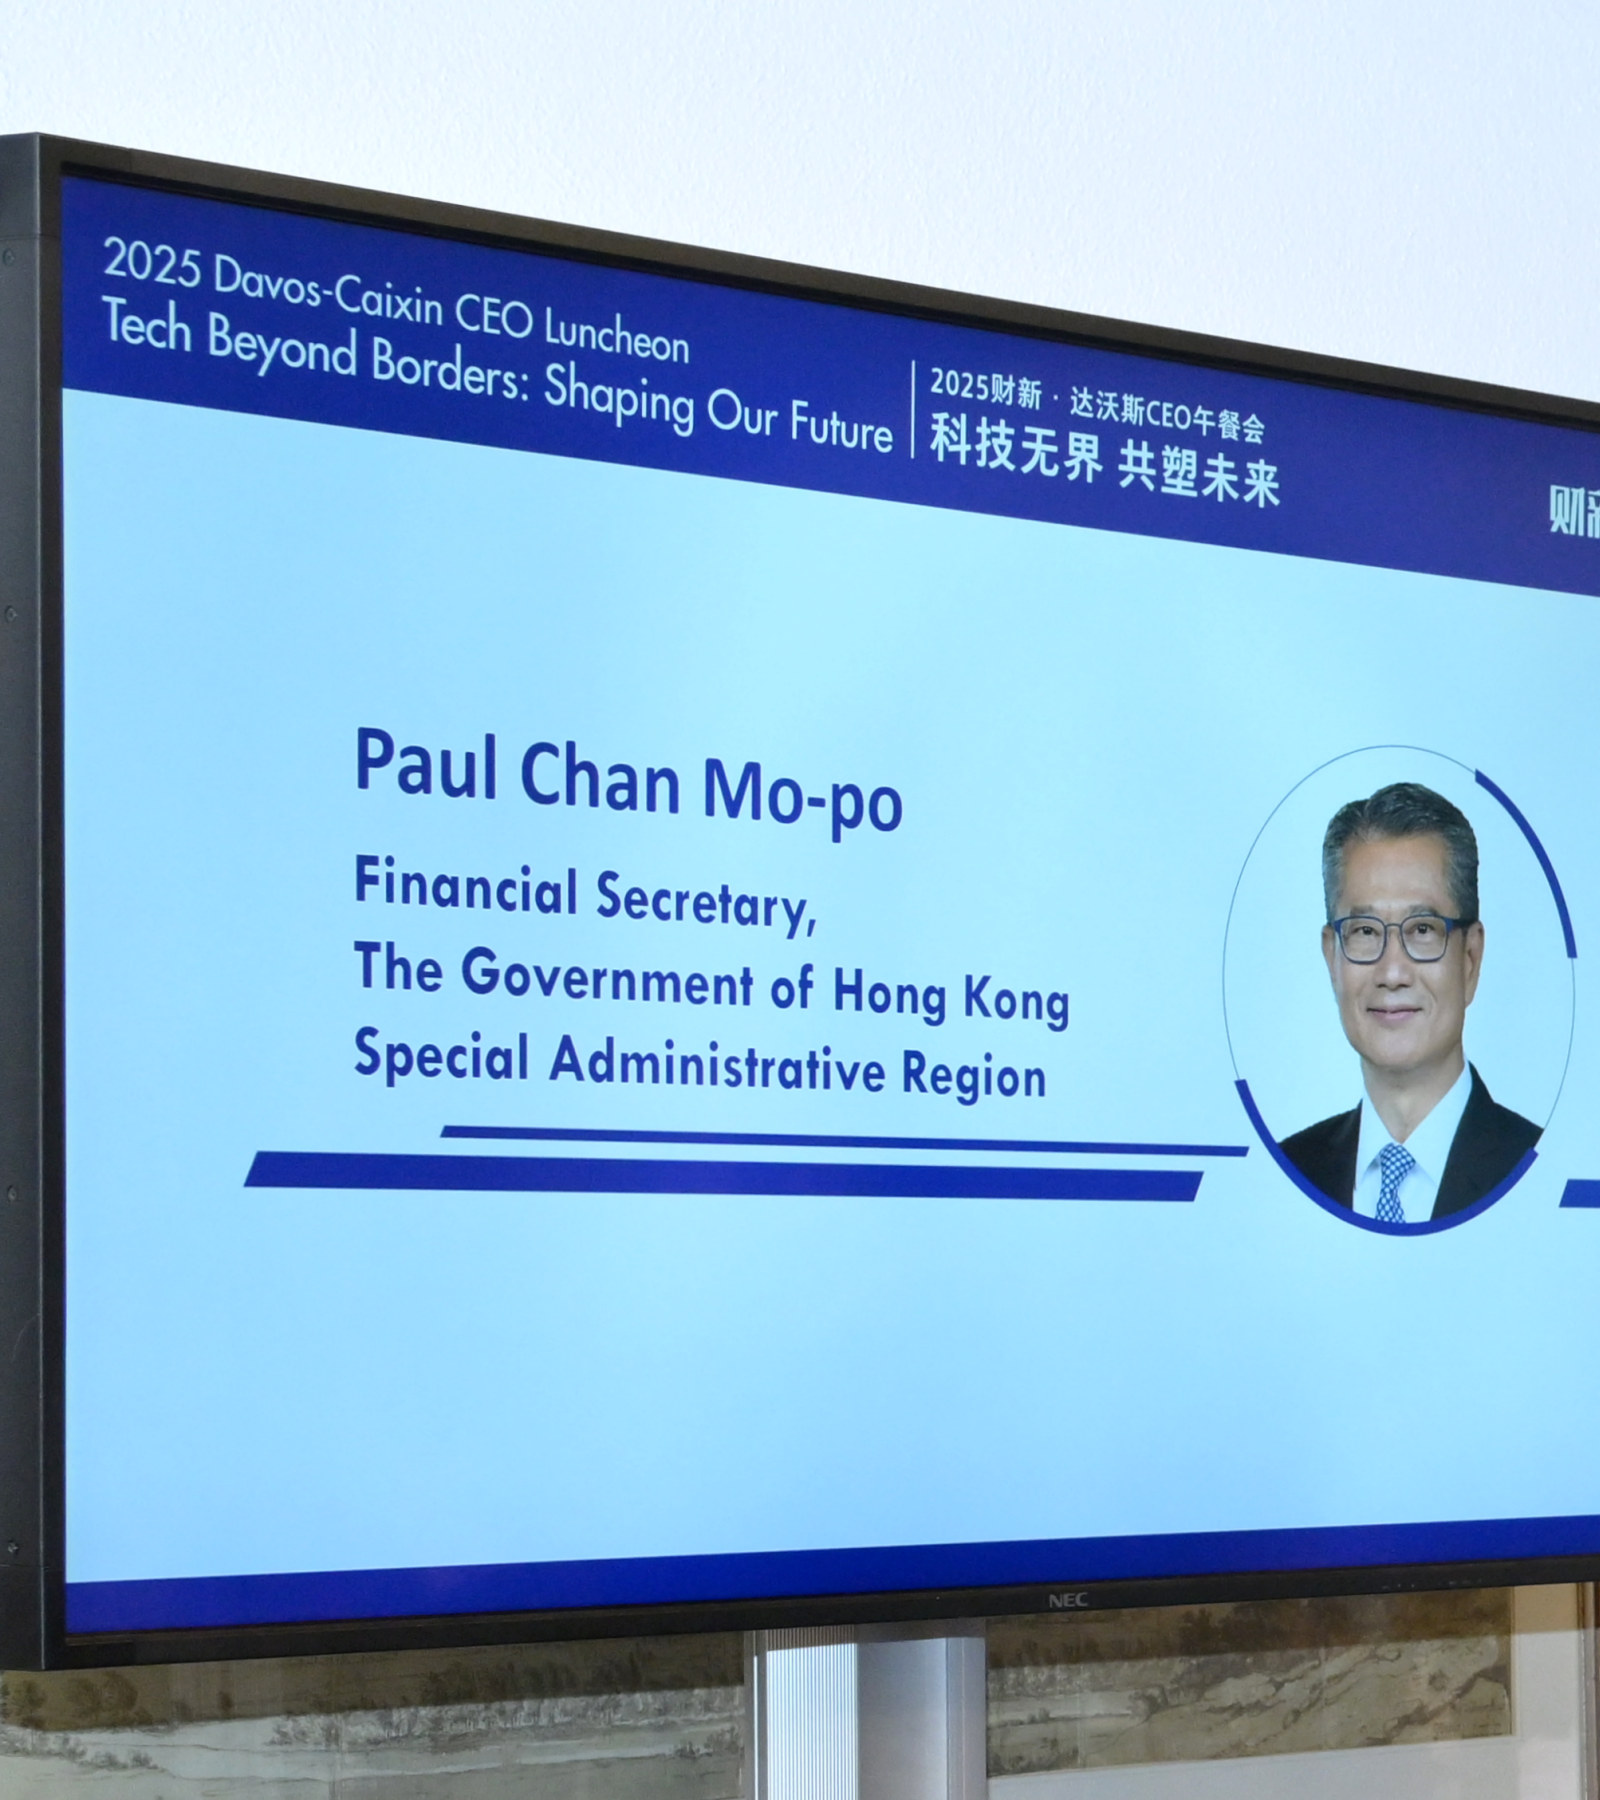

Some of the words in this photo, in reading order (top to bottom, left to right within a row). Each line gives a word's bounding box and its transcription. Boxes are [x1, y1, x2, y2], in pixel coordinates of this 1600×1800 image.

[104, 236, 201, 288] 2025
[214, 253, 443, 326] Davos-Caixin
[455, 293, 534, 339] CEO
[545, 306, 690, 364] Luncheon
[102, 295, 192, 352] Tech
[209, 311, 357, 377] Beyond
[373, 336, 529, 401] Borders:
[544, 360, 695, 437] Shaping
[707, 388, 779, 436] Our
[791, 399, 894, 453] Future
[930, 411, 1104, 483] 科技无界
[1118, 438, 1281, 508] 共塑未来
[357, 726, 496, 800] Paul
[521, 740, 680, 814] Chan
[704, 758, 903, 843] Mo-po
[355, 854, 577, 914] Financial
[597, 870, 817, 940] Secretary,
[353, 940, 443, 994] The
[461, 945, 754, 1007] Government
[771, 963, 814, 1009] of
[834, 967, 946, 1026] Hong
[964, 973, 1070, 1032] Kong
[353, 1026, 529, 1088] Special
[549, 1033, 886, 1093] Administrative
[902, 1049, 1046, 1106] Region
[1048, 1592, 1089, 1608] NEC
